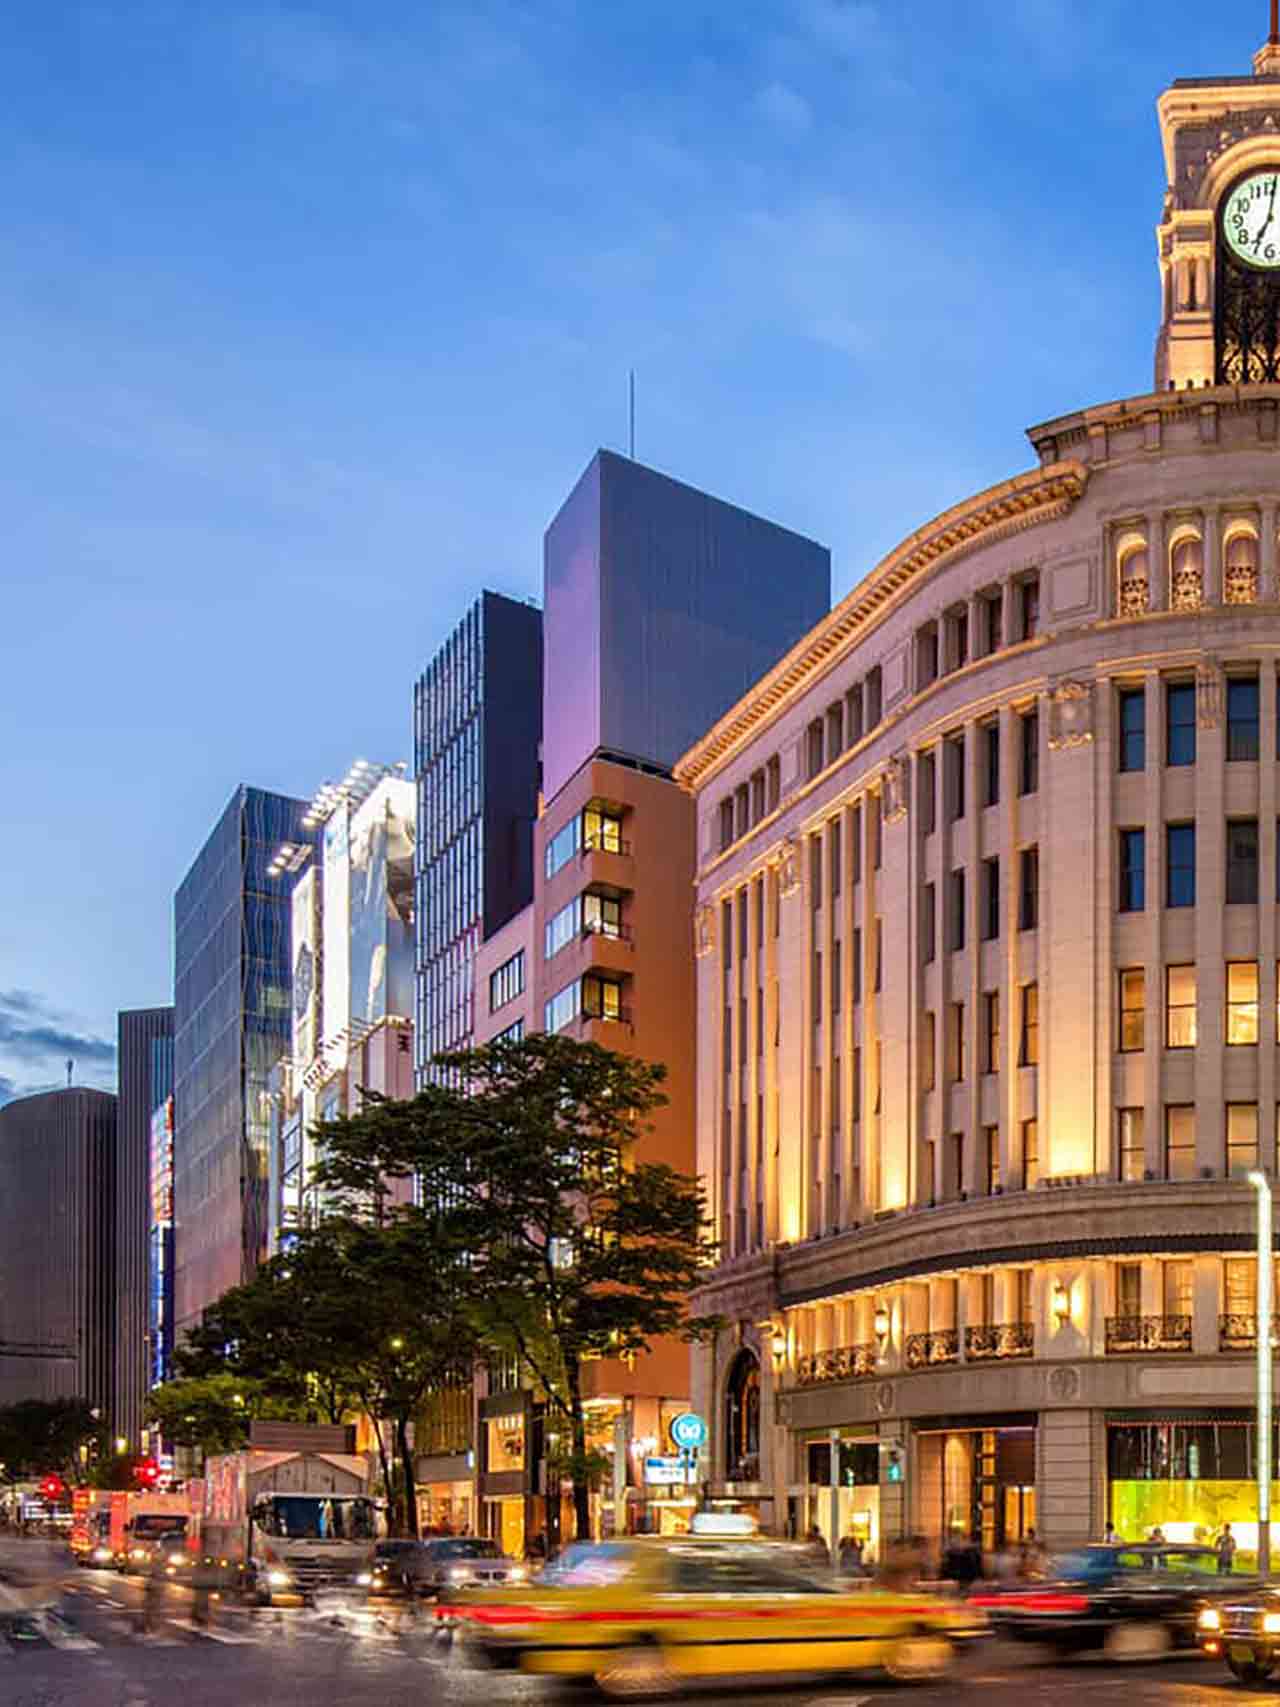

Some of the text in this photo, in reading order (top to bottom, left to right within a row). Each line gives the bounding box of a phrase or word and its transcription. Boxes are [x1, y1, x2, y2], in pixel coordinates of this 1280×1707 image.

[1250, 184, 1261, 199] 11
[1237, 198, 1250, 213] 10
[1232, 214, 1244, 230] 9
[1238, 228, 1249, 245] 8
[1264, 243, 1275, 258] 6
